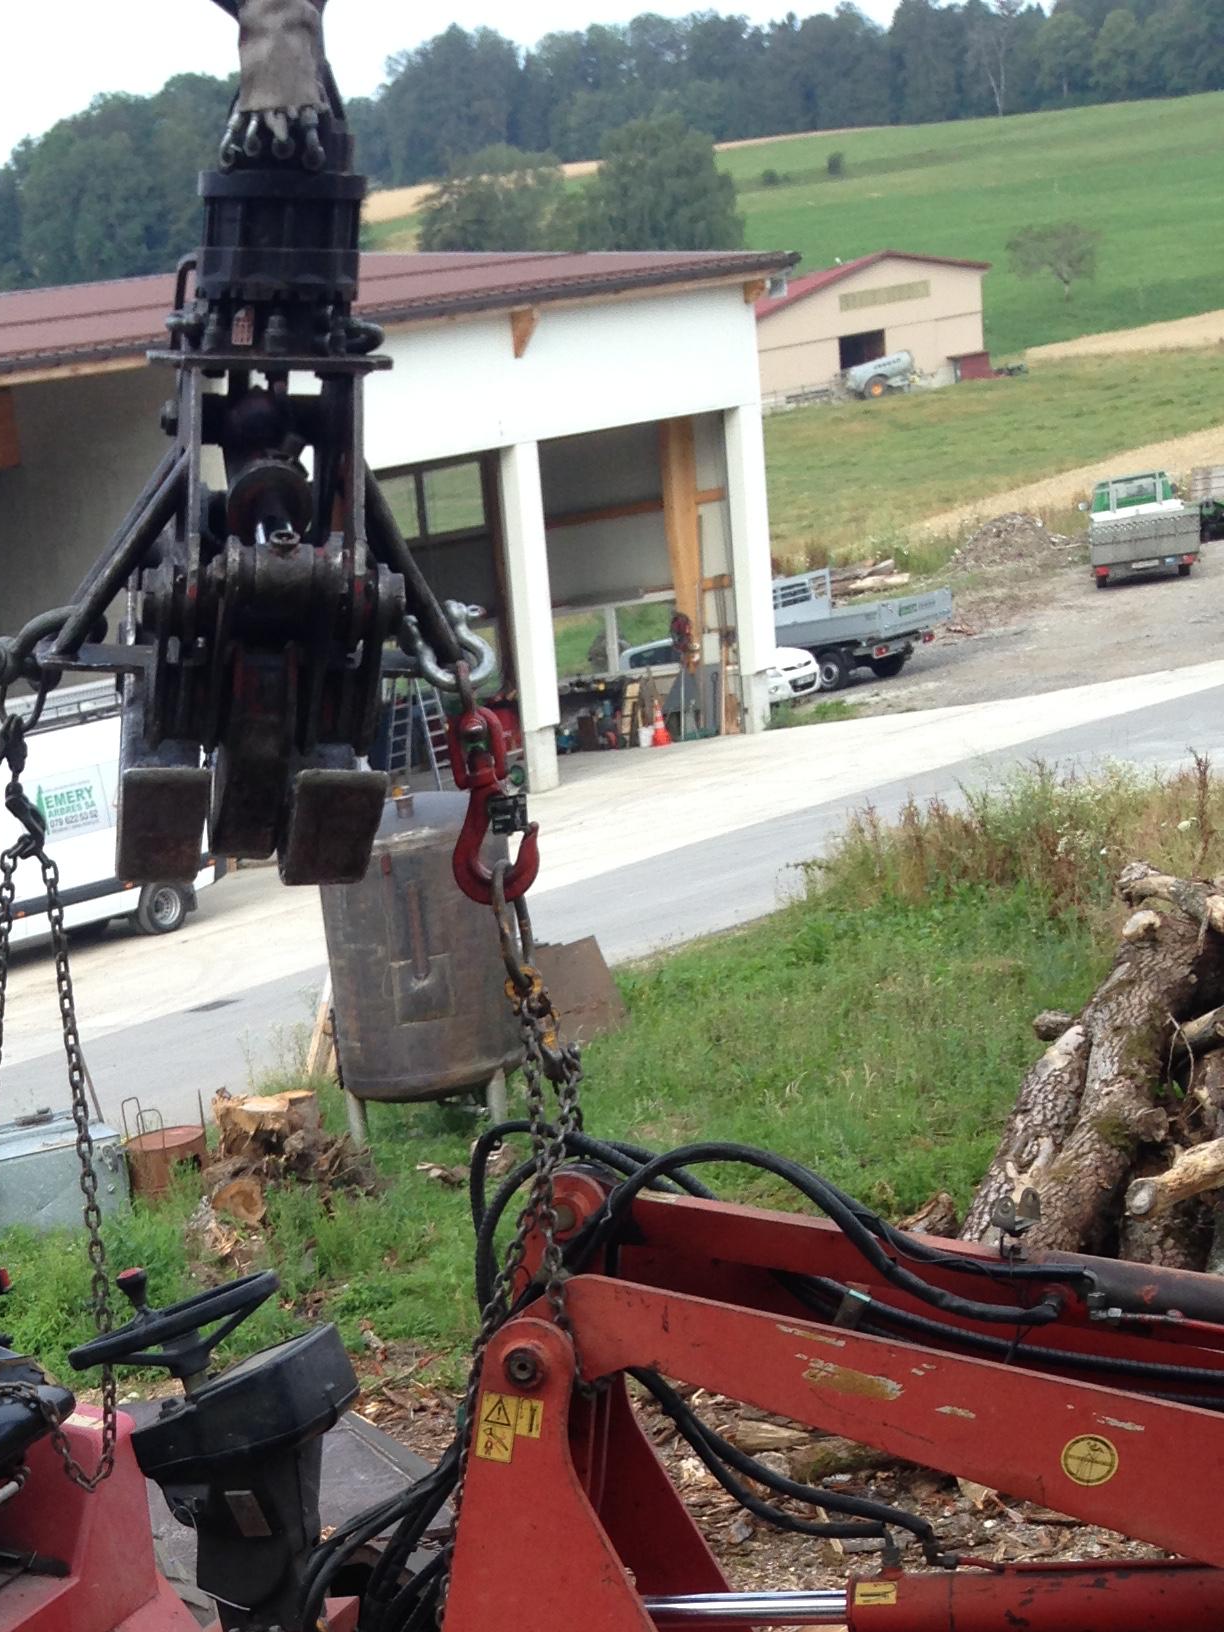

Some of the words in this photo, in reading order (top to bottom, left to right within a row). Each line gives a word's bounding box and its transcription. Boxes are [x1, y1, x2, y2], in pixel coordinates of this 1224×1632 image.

[44, 785, 93, 809] EMERY
[48, 803, 83, 818] ARBRES
[84, 800, 96, 810] SA
